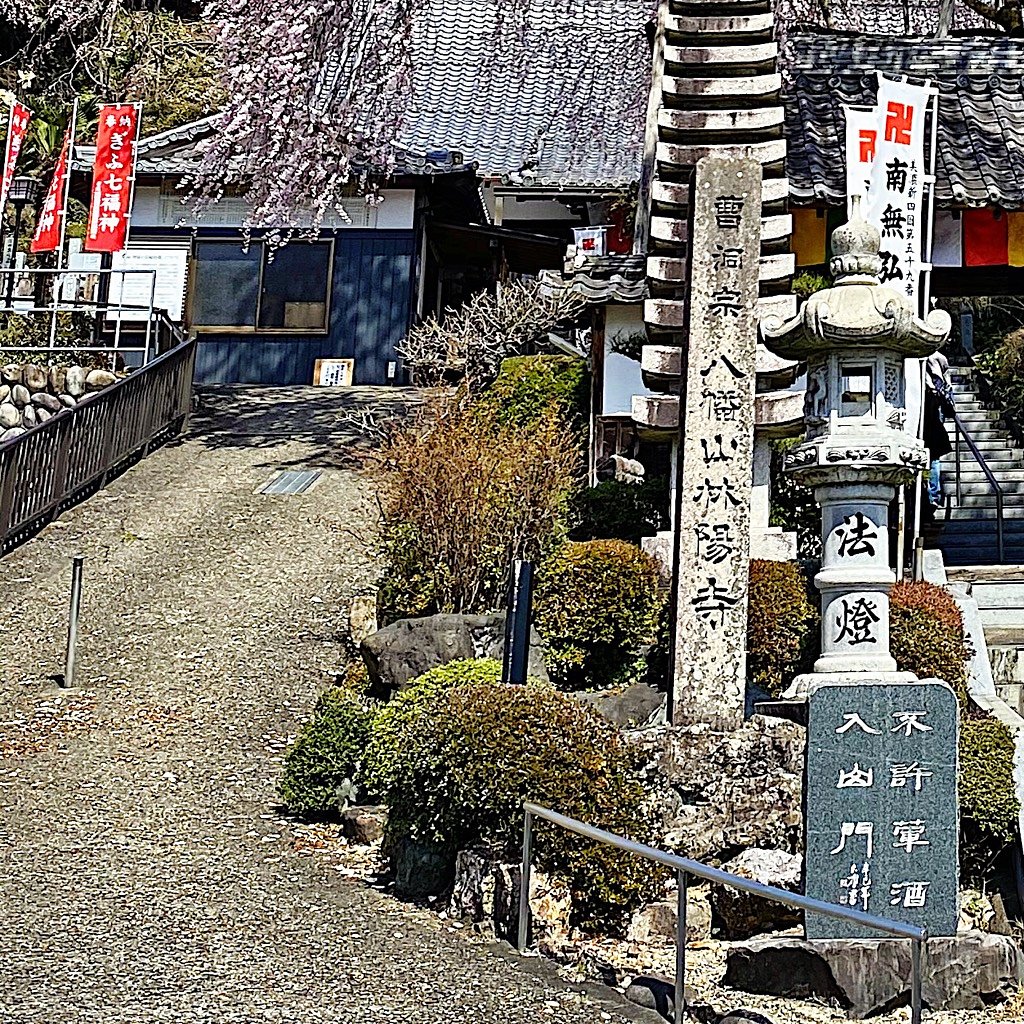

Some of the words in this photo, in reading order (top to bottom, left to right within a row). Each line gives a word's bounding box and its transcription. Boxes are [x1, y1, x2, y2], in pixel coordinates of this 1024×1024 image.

[99, 132, 127, 234] ぎふ七福神
[834, 512, 880, 646] 法燈
[830, 712, 882, 859] 入山門
[889, 710, 934, 908] 不許葷酒
